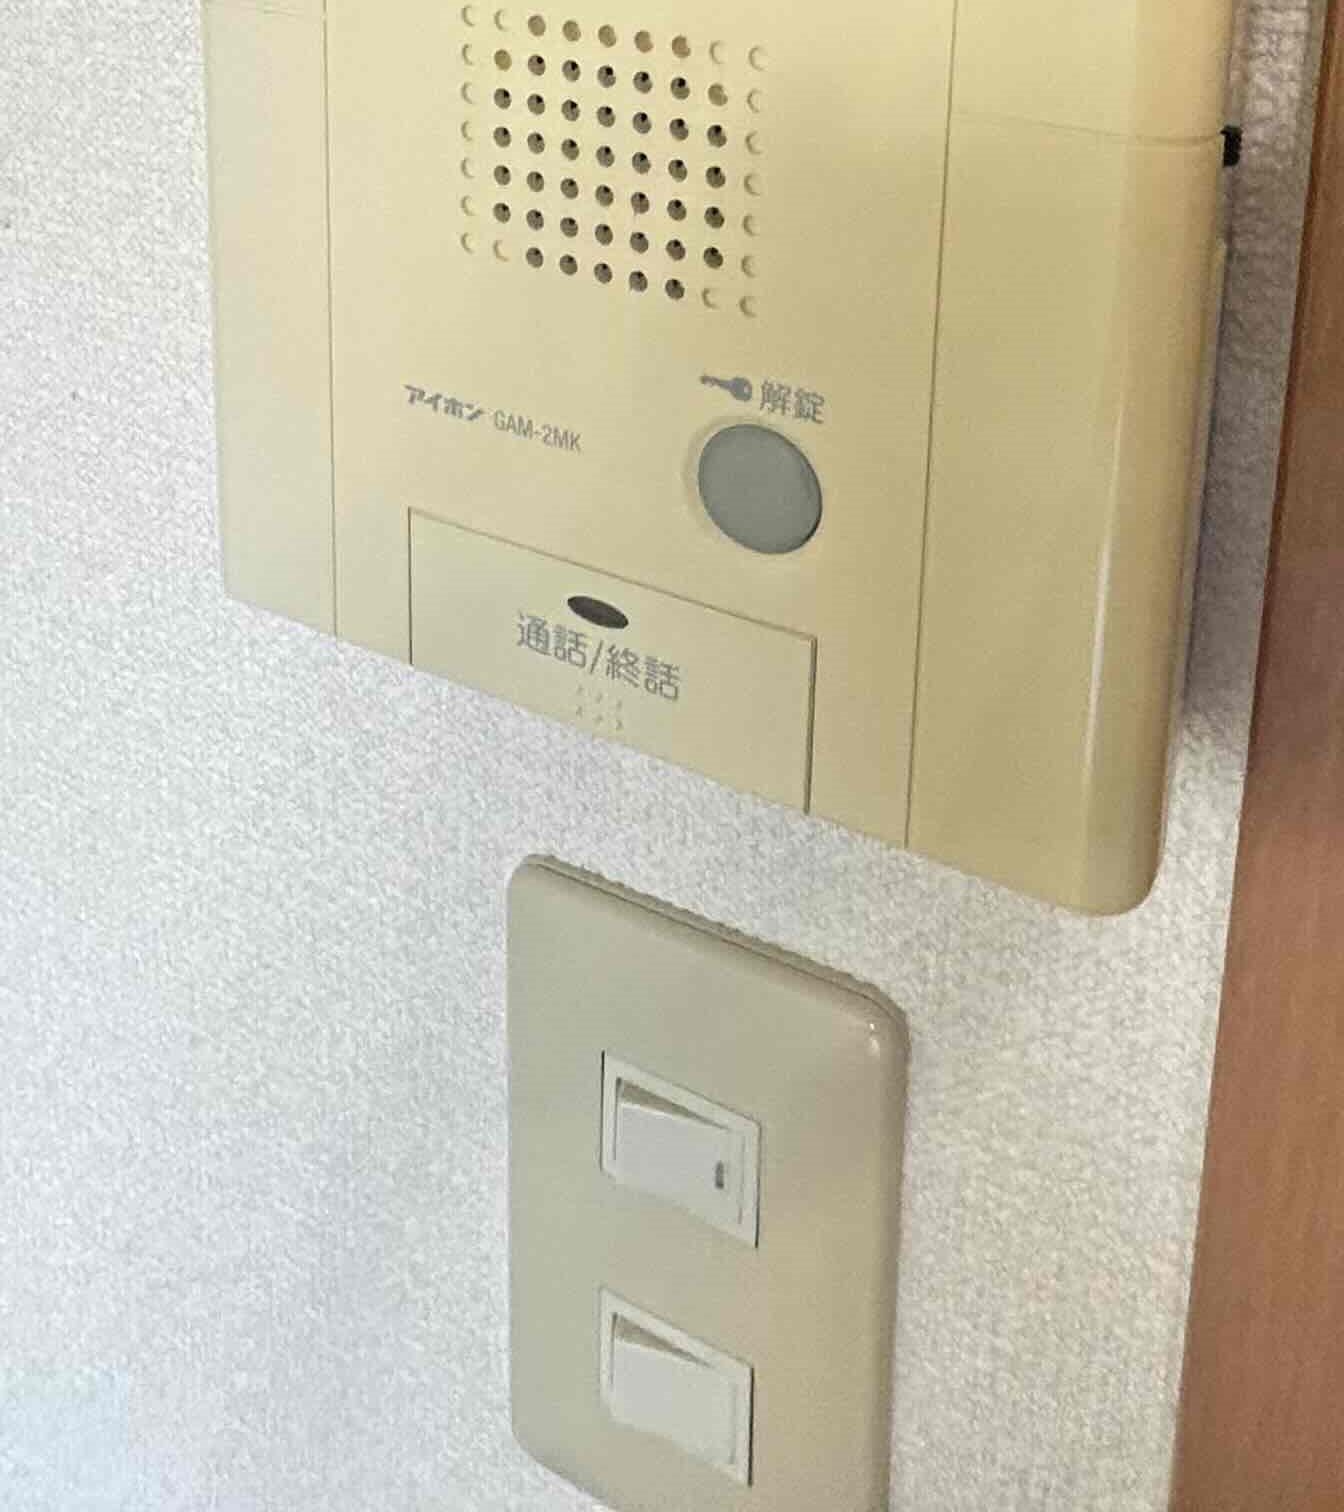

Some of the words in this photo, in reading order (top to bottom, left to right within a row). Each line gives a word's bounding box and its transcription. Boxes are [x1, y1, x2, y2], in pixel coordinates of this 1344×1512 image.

[404, 384, 484, 422] アイホン
[492, 409, 582, 453] GAM-2MK
[759, 378, 826, 426] 解錠
[516, 610, 682, 702] 通話/終話
